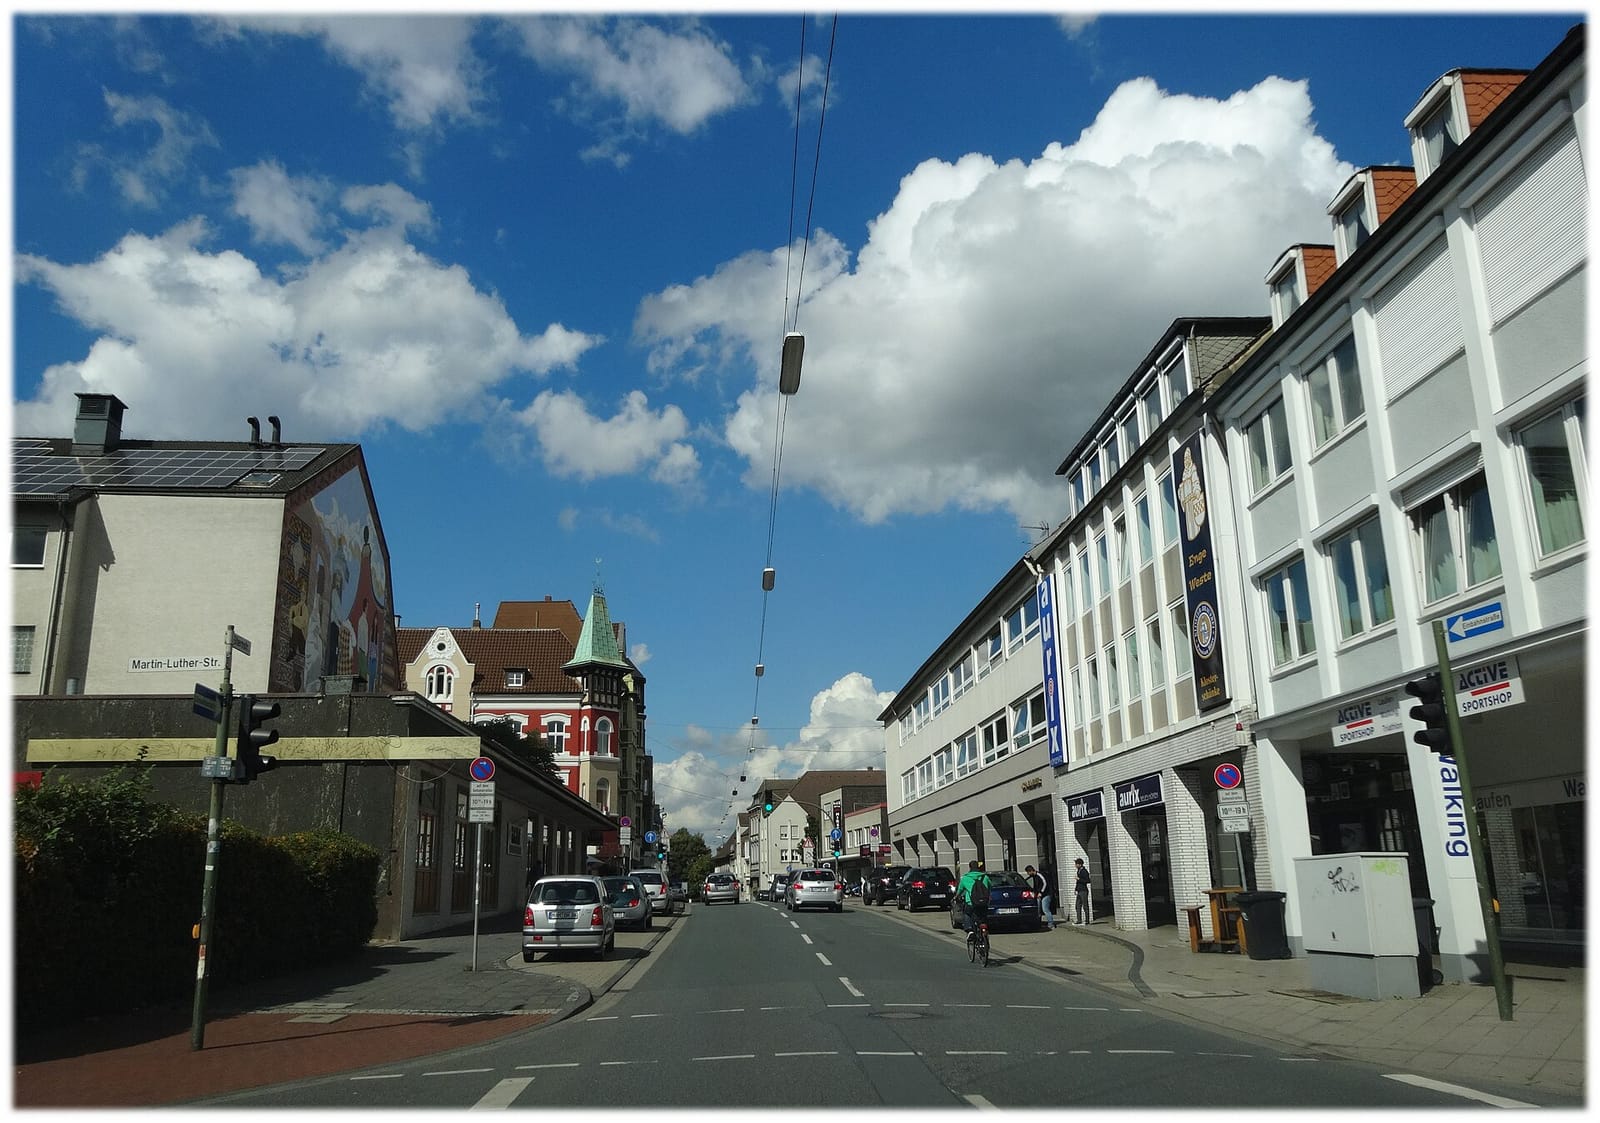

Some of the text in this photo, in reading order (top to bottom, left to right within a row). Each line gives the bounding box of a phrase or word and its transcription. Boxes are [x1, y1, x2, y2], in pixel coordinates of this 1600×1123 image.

[1188, 549, 1207, 567] Enge
[1188, 571, 1211, 591] Weste
[131, 657, 221, 670] Martin-Luther-Str.
[1040, 580, 1060, 755] aurix
[1462, 691, 1512, 713] SPORTSHOP
[1340, 726, 1375, 743] SPORTSHOP
[1119, 783, 1140, 807] aurix
[1071, 798, 1088, 818] aurix
